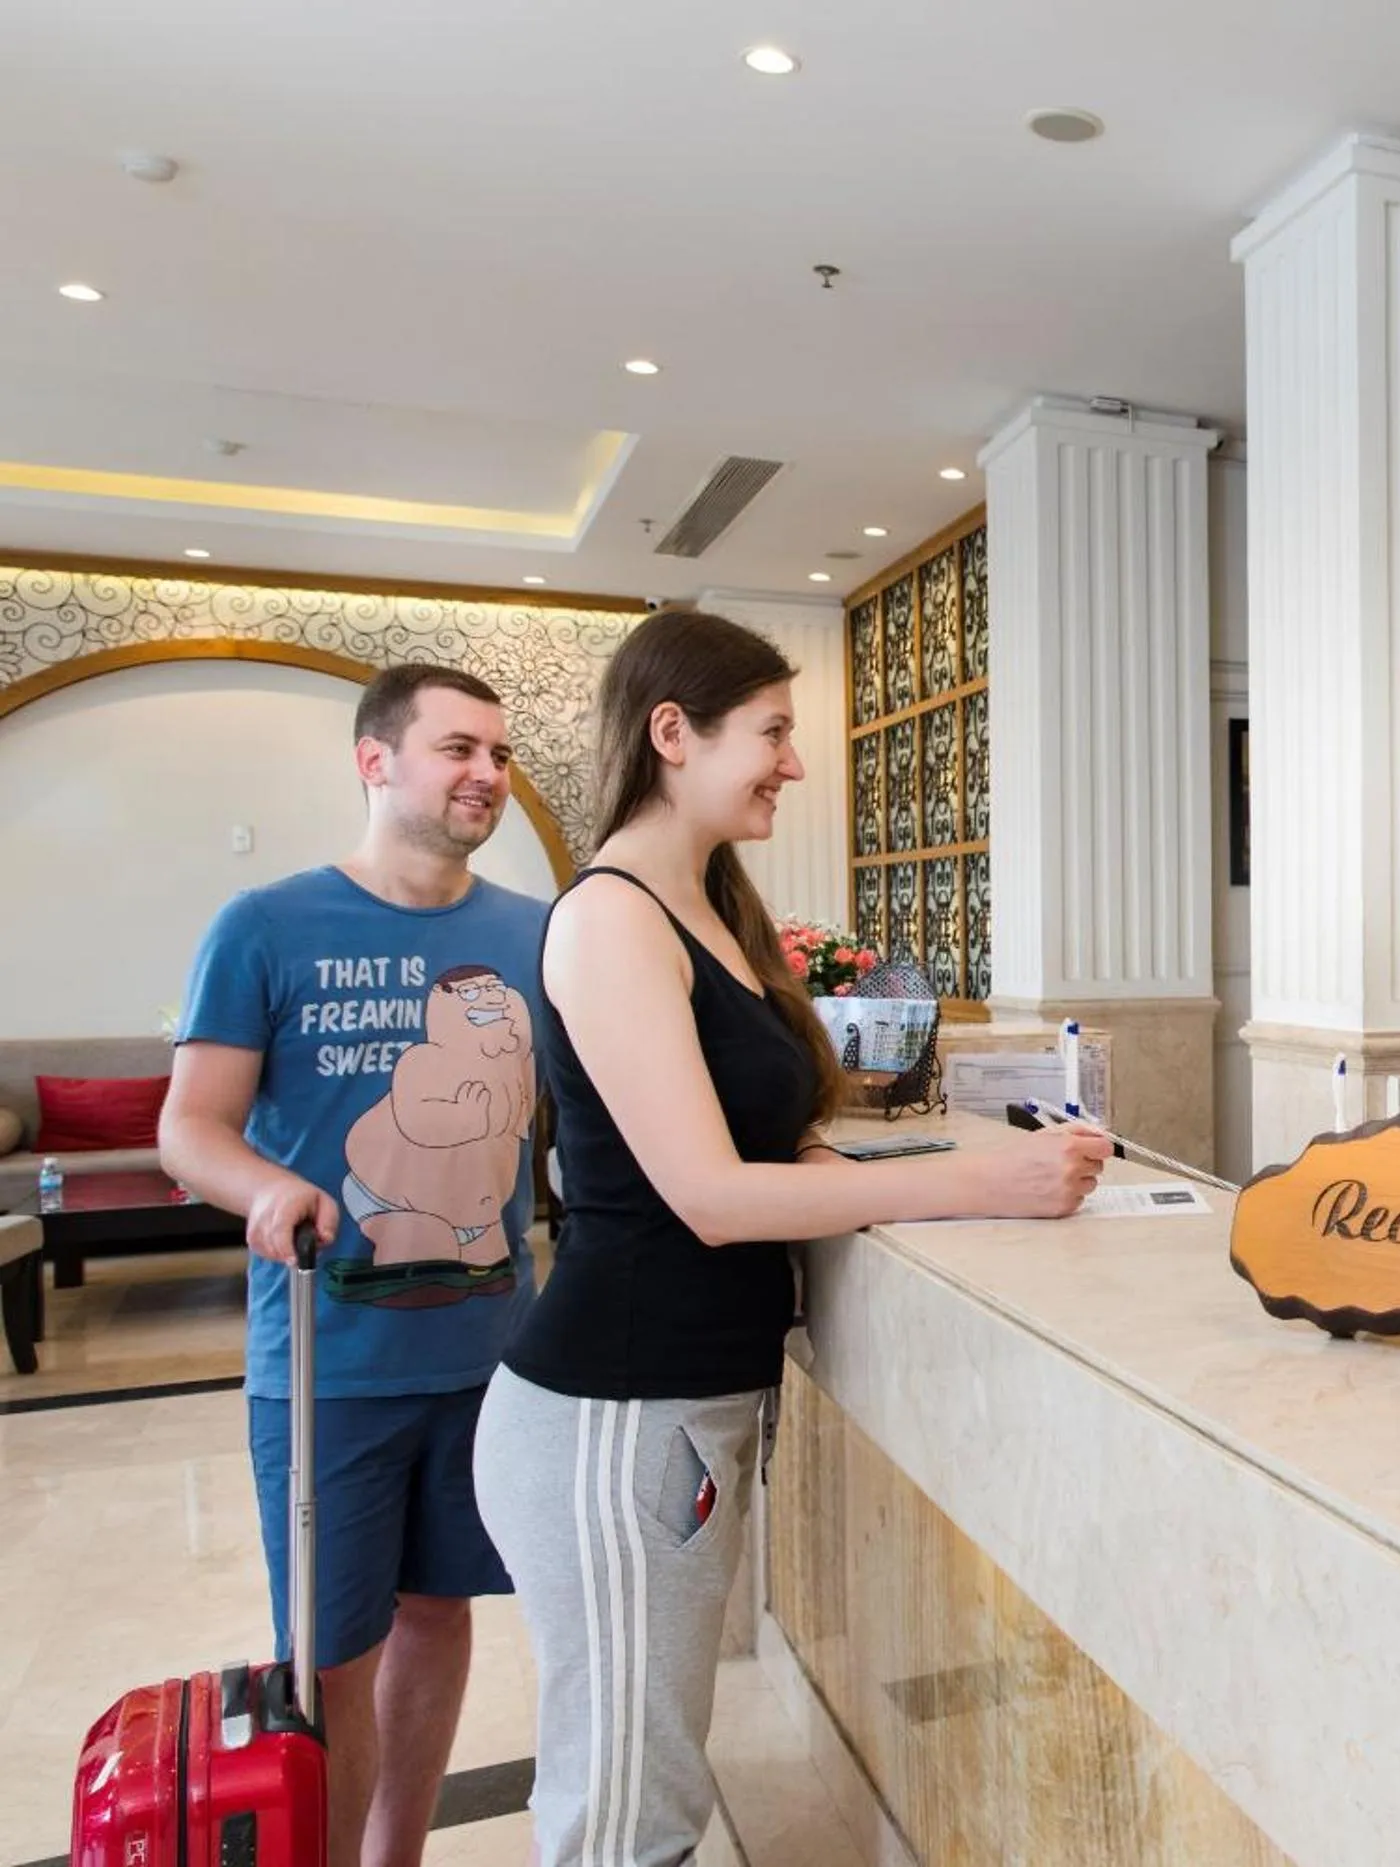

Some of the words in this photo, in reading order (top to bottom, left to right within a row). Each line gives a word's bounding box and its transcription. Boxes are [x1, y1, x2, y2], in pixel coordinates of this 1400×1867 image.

[315, 957, 391, 989] THAT
[401, 955, 426, 987] IS
[301, 999, 422, 1034] FREAKIN
